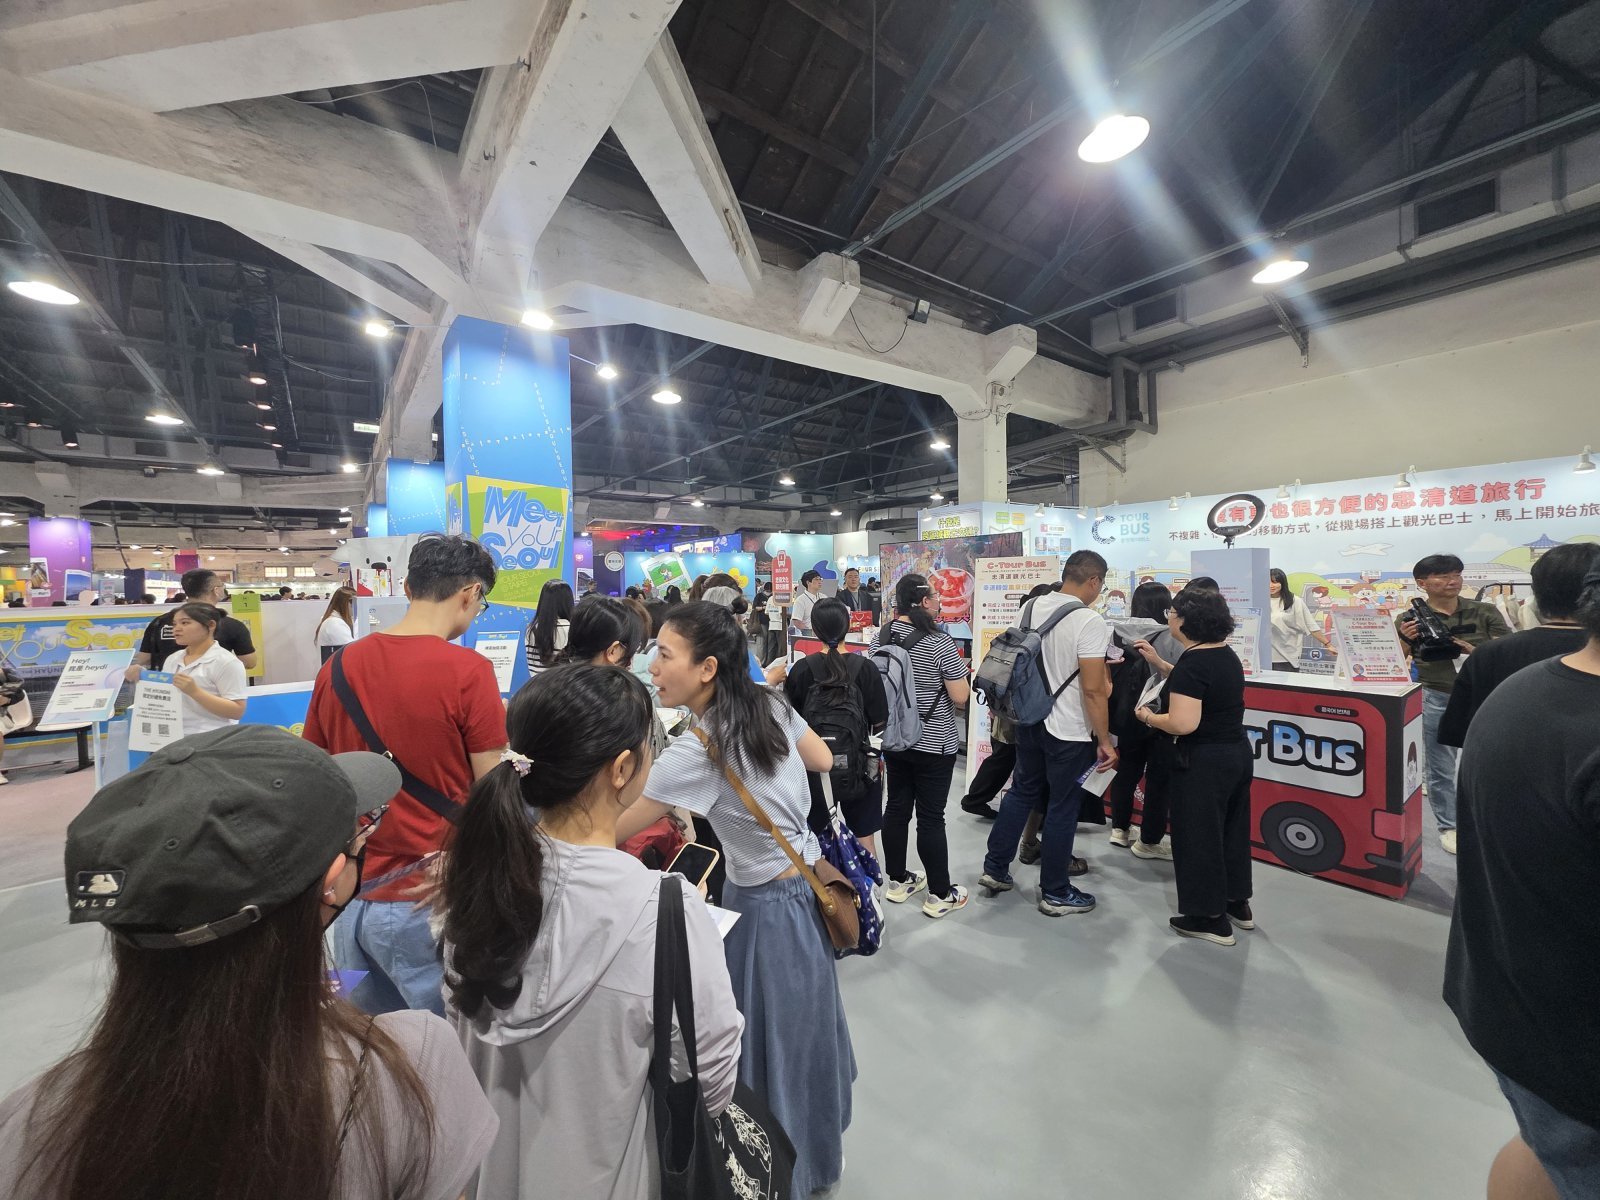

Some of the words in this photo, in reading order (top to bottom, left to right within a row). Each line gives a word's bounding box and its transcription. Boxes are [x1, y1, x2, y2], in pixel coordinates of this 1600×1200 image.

[484, 486, 564, 527] Meet
[1120, 513, 1149, 521] TOUR
[1120, 522, 1150, 536] BUS
[1270, 722, 1361, 774] Bus
